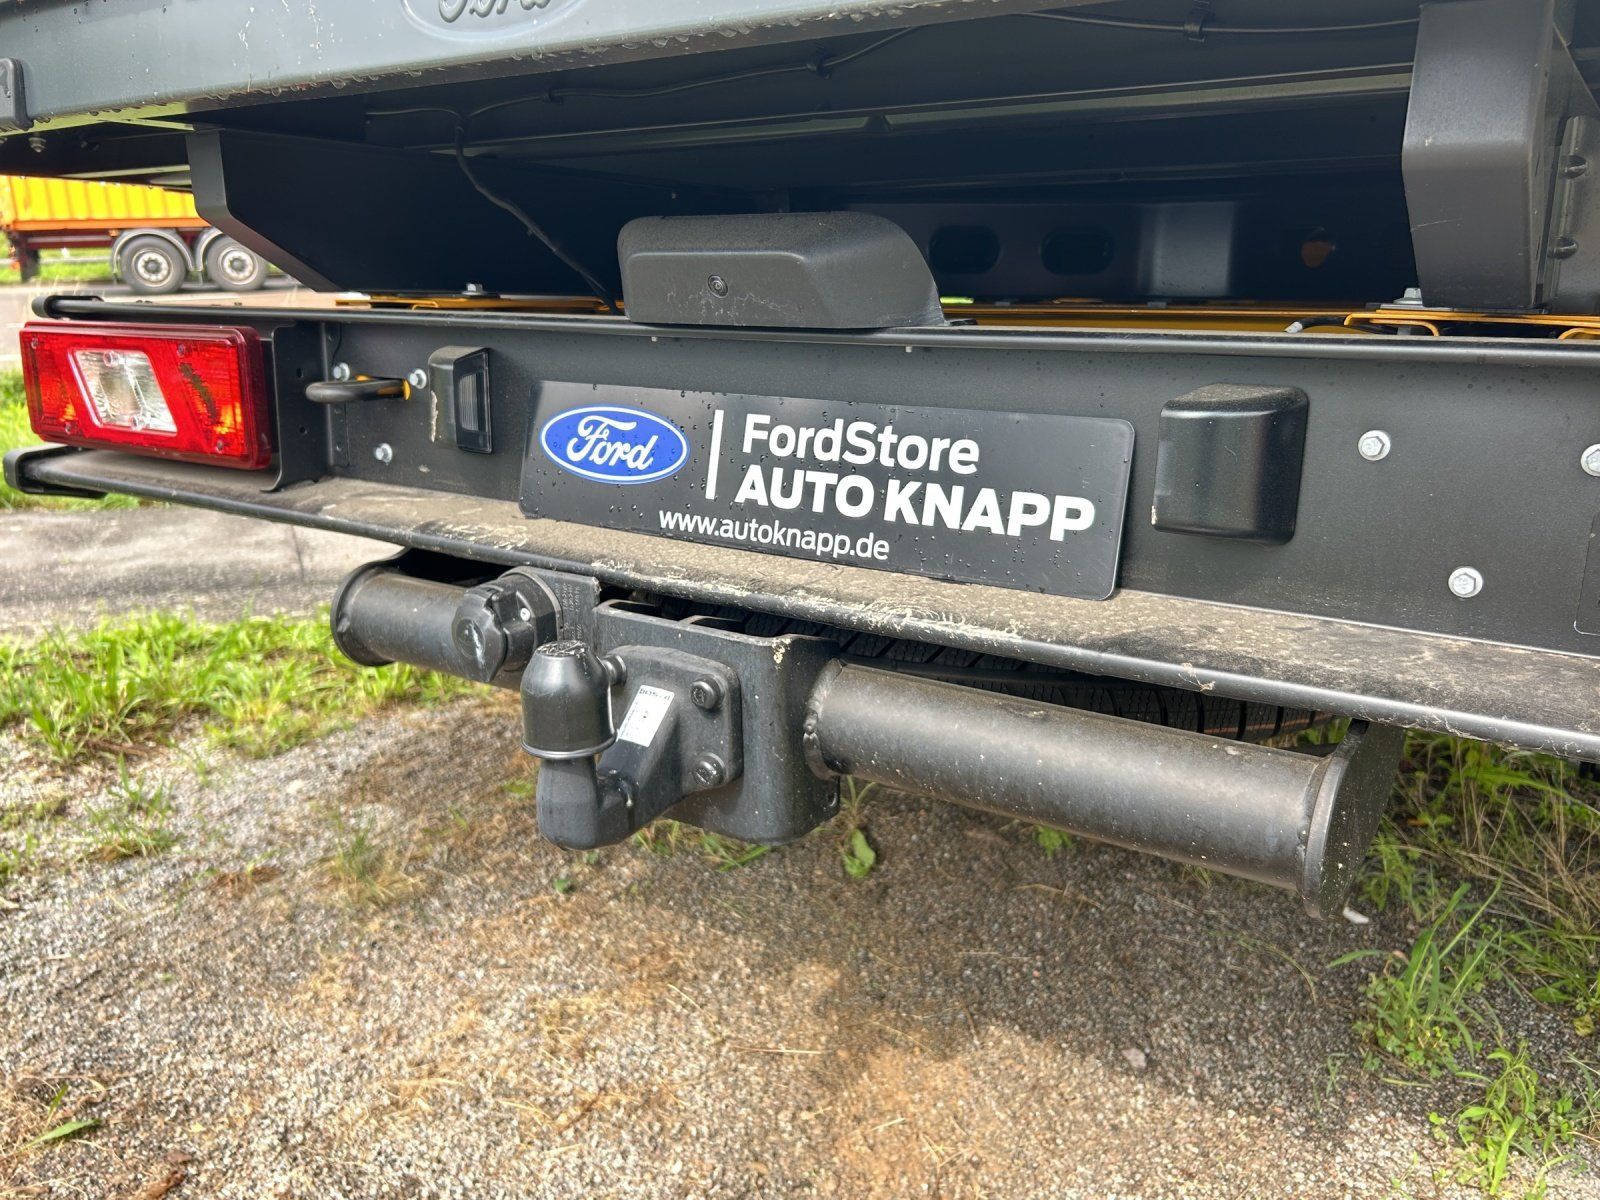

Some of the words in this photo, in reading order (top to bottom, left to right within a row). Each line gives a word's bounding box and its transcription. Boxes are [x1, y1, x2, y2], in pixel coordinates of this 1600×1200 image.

[566, 415, 659, 470] Ford
[742, 413, 980, 474] FordStore
[734, 464, 875, 518] AUTO
[883, 479, 1096, 541] KNAPP
[658, 509, 890, 560] www.autoknapp.de
